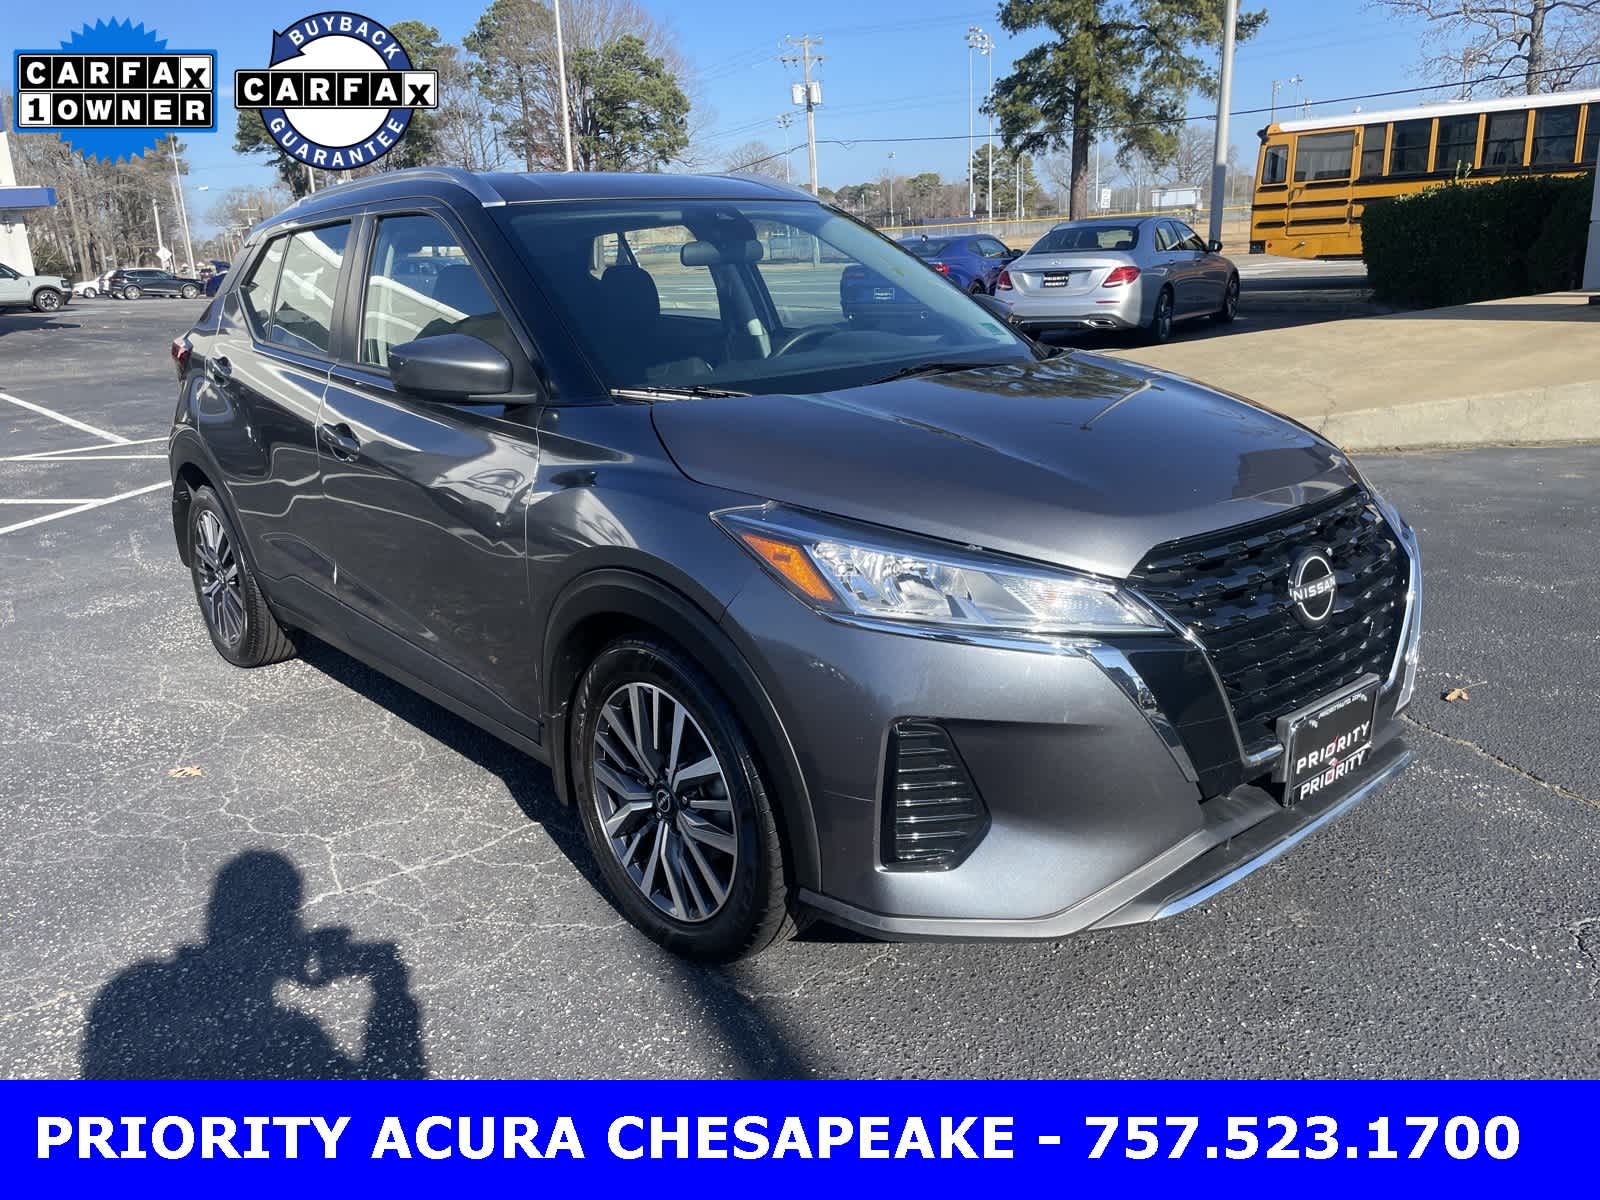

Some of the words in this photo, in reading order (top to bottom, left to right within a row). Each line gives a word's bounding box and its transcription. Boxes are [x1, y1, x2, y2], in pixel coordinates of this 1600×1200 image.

[1293, 575, 1336, 602] NISSAN
[1296, 720, 1370, 775] PRIORITY
[1300, 750, 1365, 800] PRIORITY
